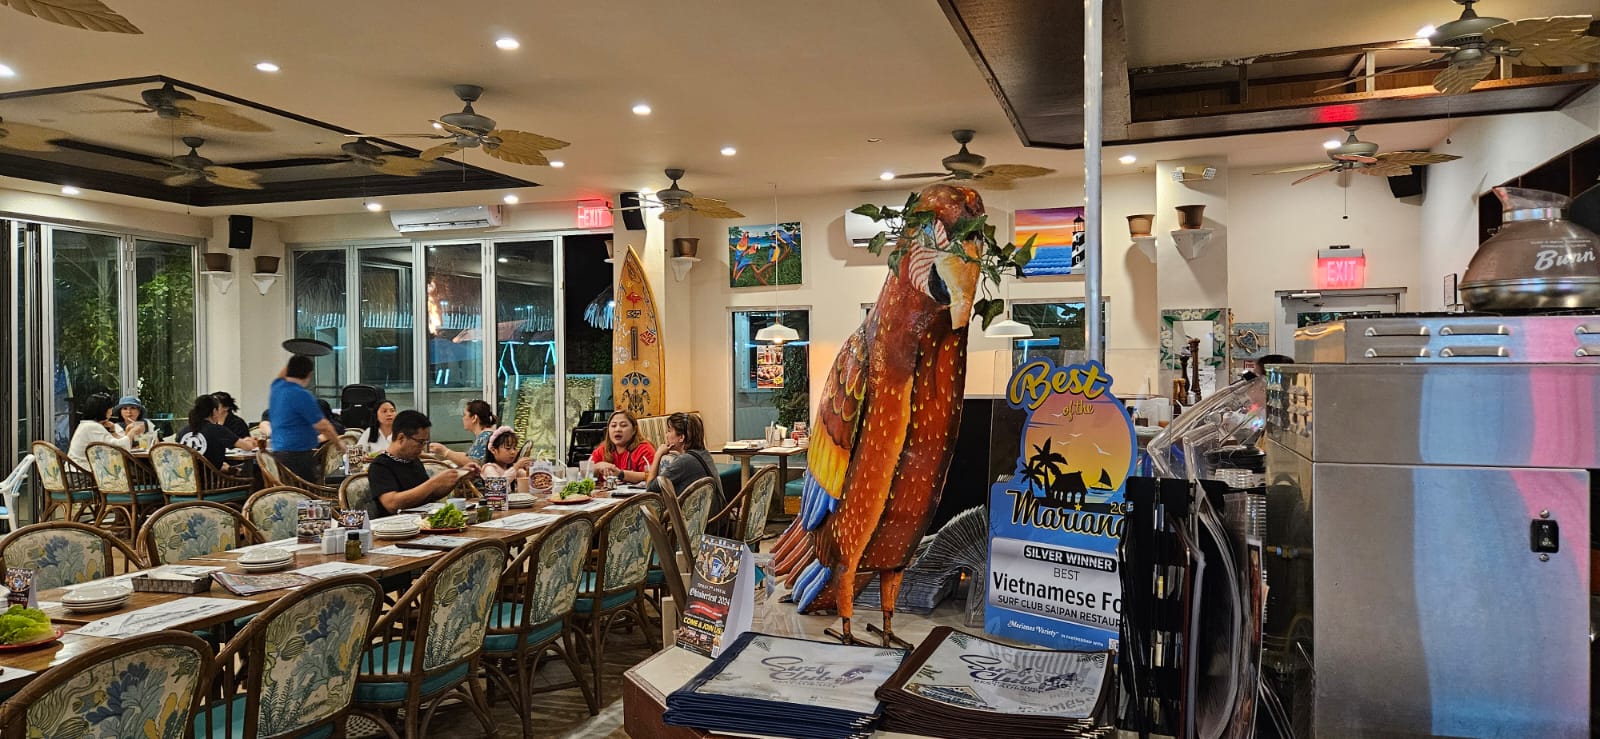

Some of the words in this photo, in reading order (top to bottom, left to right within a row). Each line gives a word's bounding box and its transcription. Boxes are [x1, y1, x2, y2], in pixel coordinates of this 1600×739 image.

[583, 208, 603, 226] EXIT
[1327, 260, 1356, 281] EXIT
[1534, 247, 1596, 271] Bunn
[1010, 361, 1108, 410] Best
[1062, 400, 1074, 422] of
[1074, 399, 1094, 415] the
[1025, 546, 1063, 562] SILVER
[1065, 552, 1113, 571] WINNER
[1053, 567, 1080, 581] BEST
[993, 571, 1096, 609] Vietnamese
[998, 594, 1019, 606] SURF
[1021, 599, 1043, 611] CLUB
[1045, 604, 1078, 618] SAIPAN
[683, 616, 699, 627] COME
[702, 622, 715, 633] JOIN
